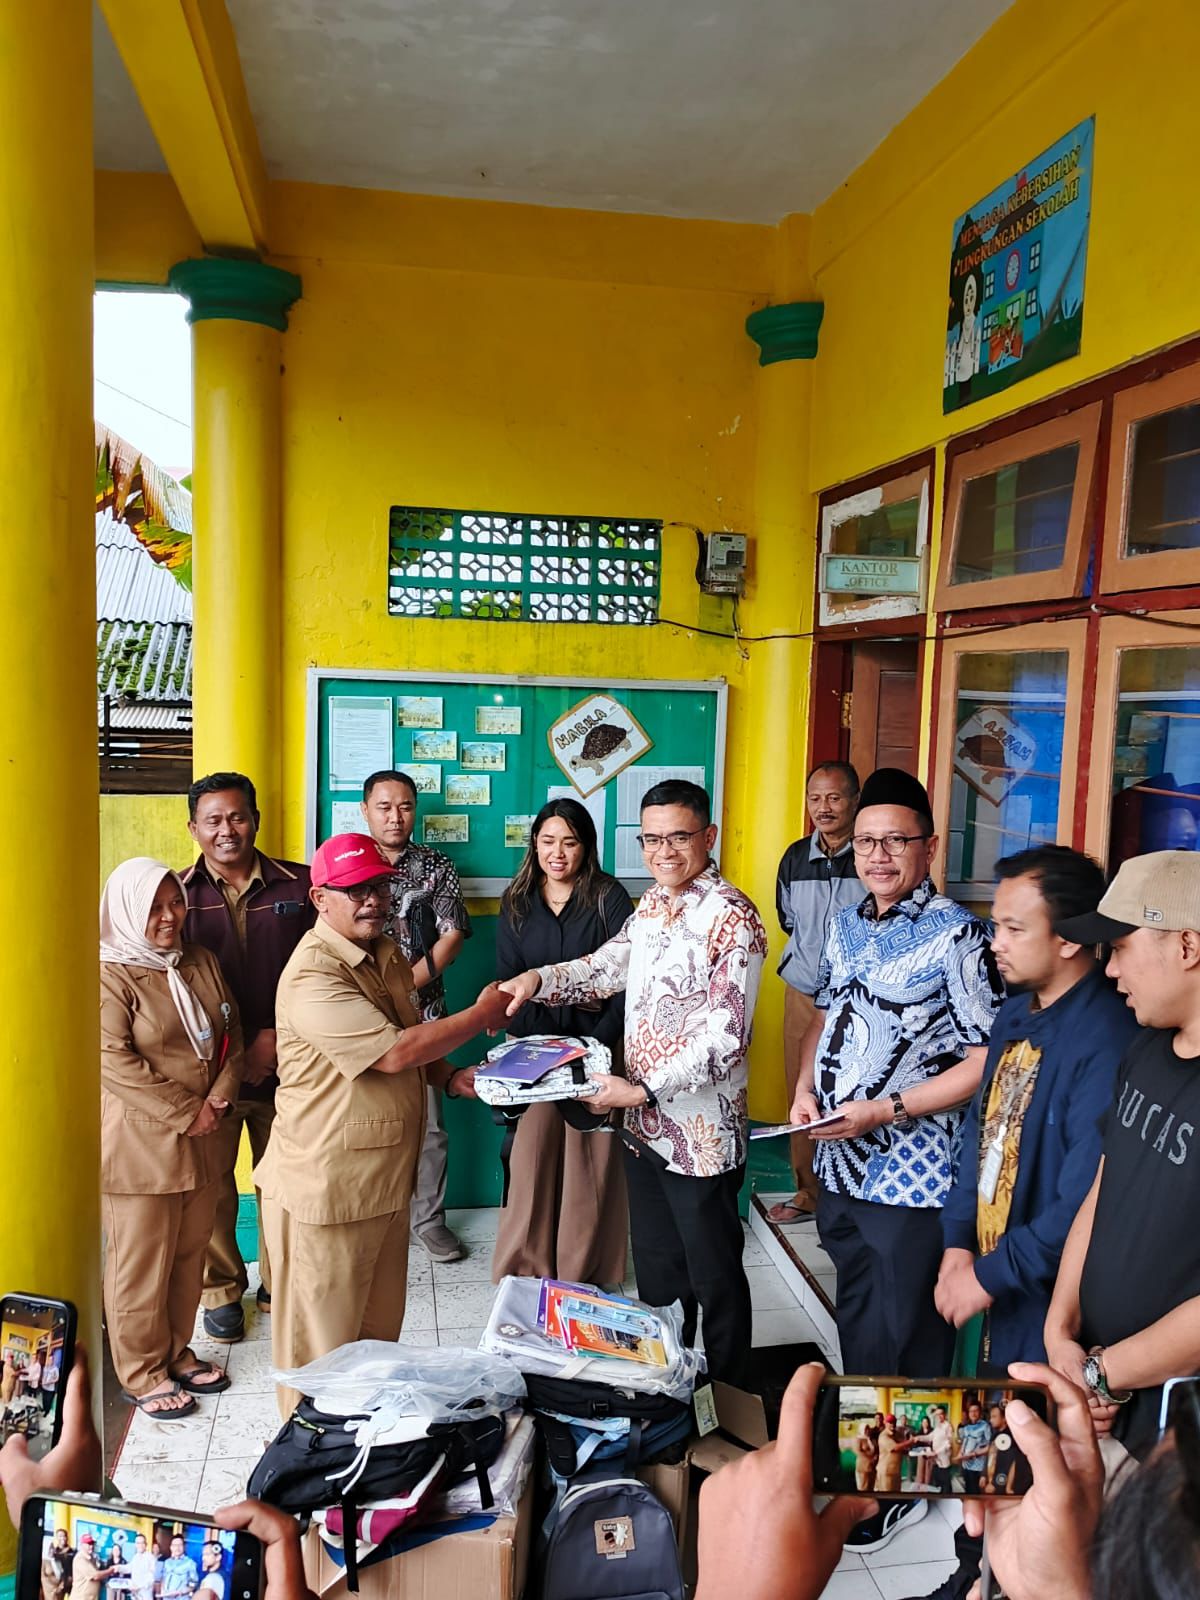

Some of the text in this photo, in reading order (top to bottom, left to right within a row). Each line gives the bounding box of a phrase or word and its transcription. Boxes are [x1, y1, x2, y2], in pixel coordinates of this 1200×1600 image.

[960, 145, 1081, 247] MENJAGA KEBERSIHAN
[960, 177, 1080, 276] LINGKUNGAN SEKOLAH
[842, 561, 898, 574] KANTOR
[849, 576, 889, 587] OFFICE
